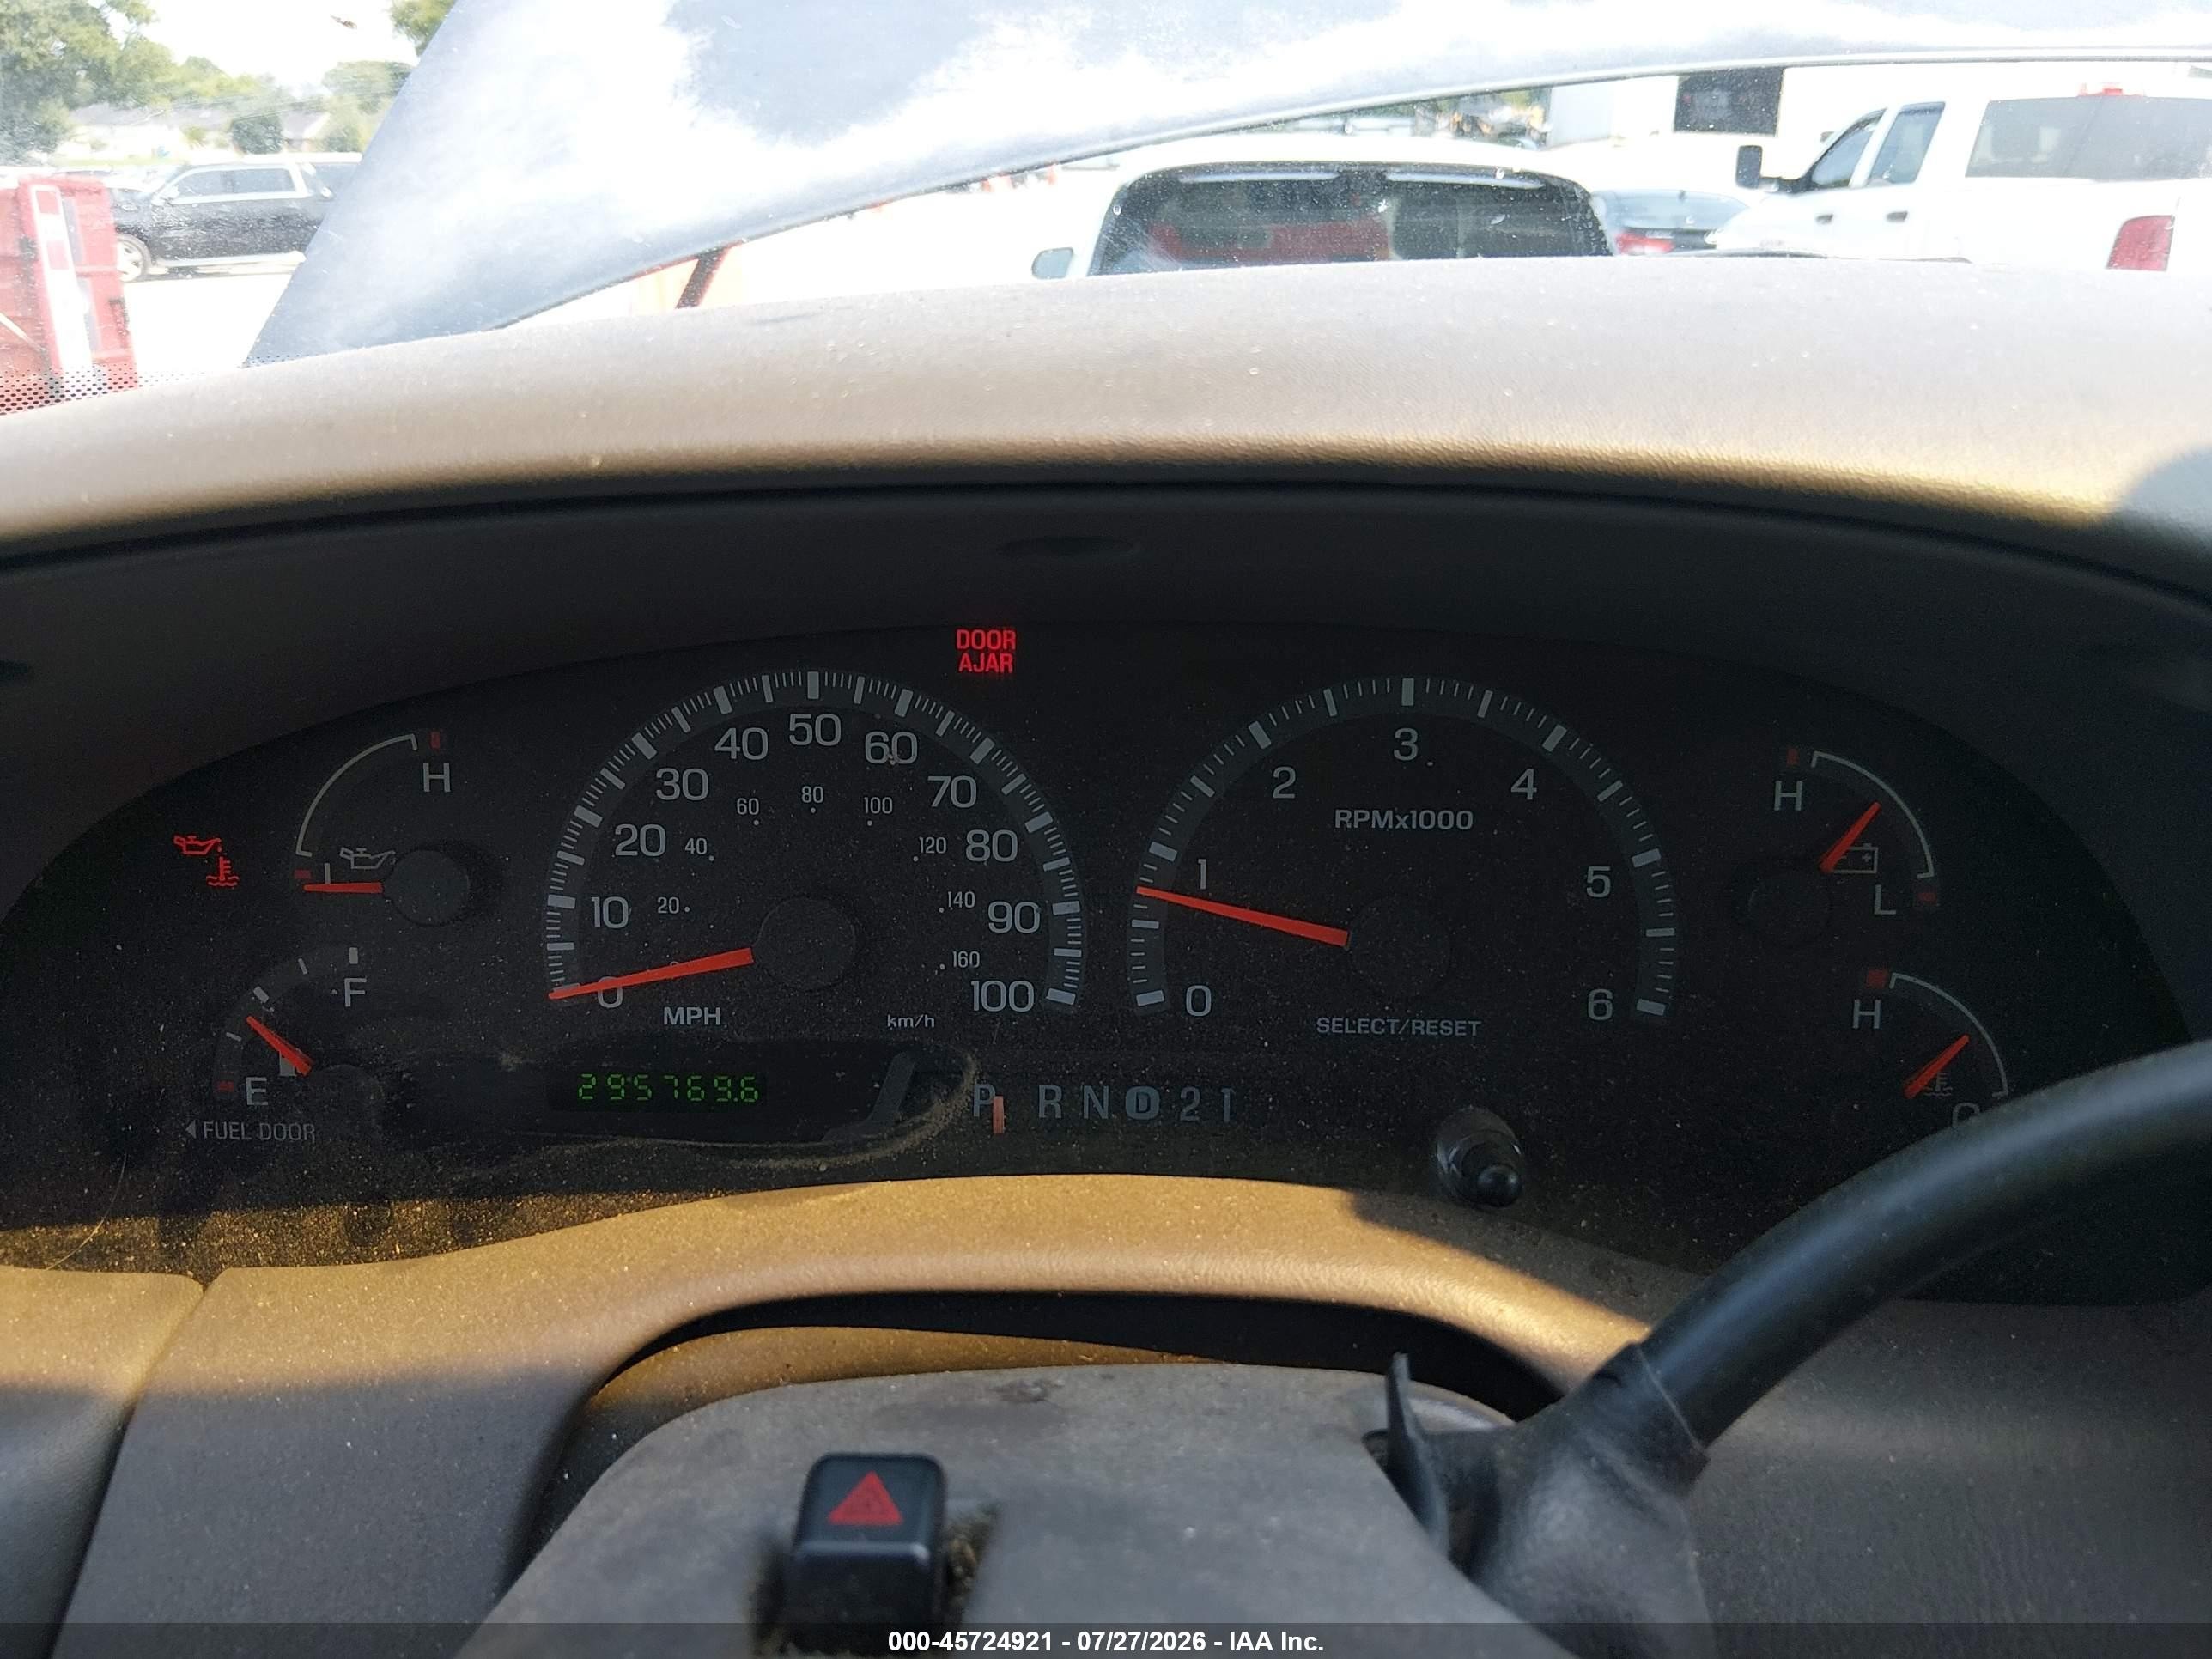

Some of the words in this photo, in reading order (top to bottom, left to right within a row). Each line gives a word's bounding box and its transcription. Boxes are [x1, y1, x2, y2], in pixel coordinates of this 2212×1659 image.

[955, 629, 1017, 650] DOOR
[957, 653, 1015, 673] AJAR
[714, 727, 769, 761] 40
[788, 714, 842, 746] 50
[1393, 727, 1420, 762] 3
[864, 731, 919, 764] 60
[422, 762, 452, 793] H
[655, 767, 710, 801] 30
[927, 775, 978, 809] 70
[1272, 765, 1297, 799] 2
[1510, 769, 1538, 801] 4
[736, 798, 761, 816] 60
[800, 786, 825, 804] 80
[864, 796, 894, 815] 100
[1773, 780, 1803, 811] H
[1334, 809, 1474, 831] RPMx1000
[614, 823, 667, 857] 20
[684, 837, 708, 856] 40
[918, 836, 947, 854] 120
[964, 829, 1018, 862] 80
[1197, 859, 1208, 890] 1
[1585, 866, 1613, 898] 5
[591, 896, 631, 929] 10
[657, 896, 680, 915] 20
[947, 890, 976, 909] 140
[1874, 884, 1897, 915] L
[988, 901, 1042, 934] 90
[951, 951, 981, 969] 160
[343, 977, 368, 1007] F
[970, 980, 1036, 1013] 100
[1185, 984, 1213, 1018] 0
[1586, 988, 1613, 1022] 6
[663, 1006, 722, 1025] MPH
[885, 1014, 936, 1029] km/h
[1316, 1017, 1482, 1037] SELECT/RESET
[1852, 999, 1882, 1030] H
[245, 1076, 269, 1106] E
[1038, 1084, 1064, 1120] R
[1082, 1085, 1109, 1120] N
[1179, 1086, 1201, 1122] 2
[203, 1121, 252, 1141] FUEL
[258, 1122, 316, 1145] DOOR
